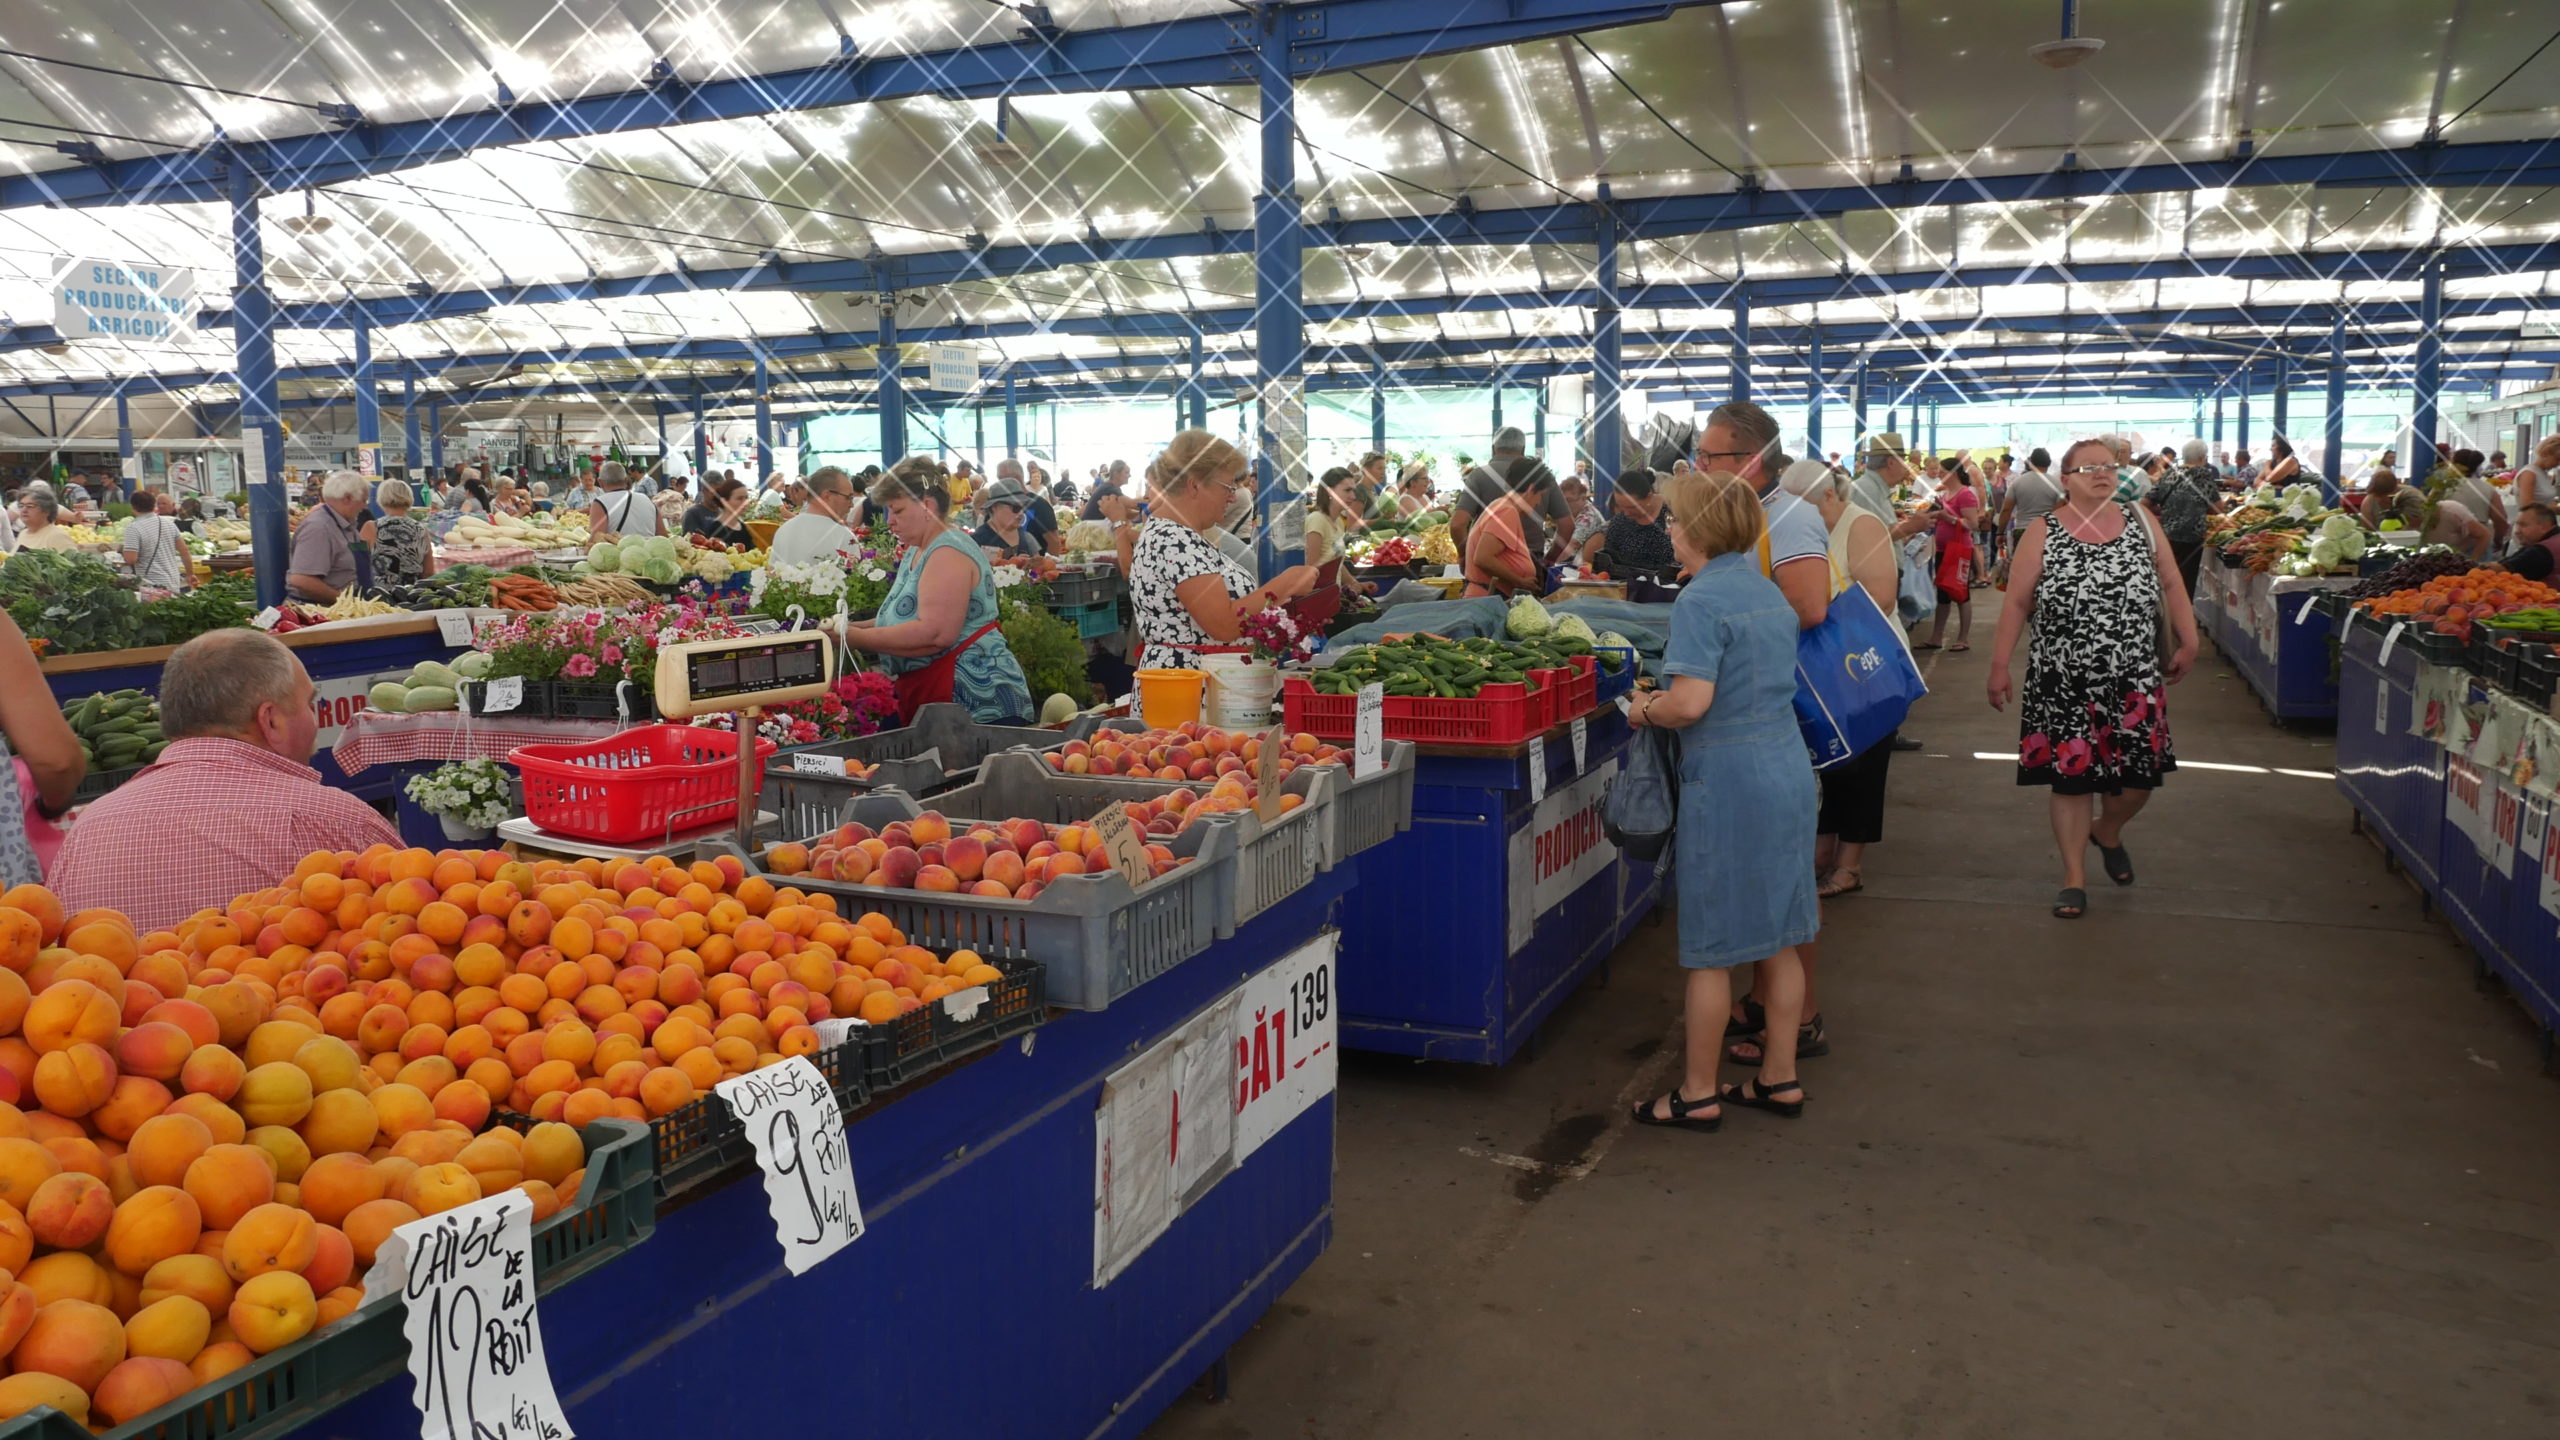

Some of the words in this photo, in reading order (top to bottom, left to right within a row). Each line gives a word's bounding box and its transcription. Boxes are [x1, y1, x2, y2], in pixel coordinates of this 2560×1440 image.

[93, 266, 159, 288] SECTOR
[88, 316, 170, 337] AGRICOLI
[942, 349, 965, 361] SECTOR
[480, 438, 518, 448] DANVERT
[310, 694, 367, 729] ROD
[1118, 839, 1132, 882] 5
[1290, 964, 1329, 1039] 139
[806, 1079, 829, 1106] DE
[819, 1103, 840, 1131] LA
[768, 1108, 825, 1245] 9
[504, 1250, 524, 1280] DE
[501, 1278, 523, 1311] LA
